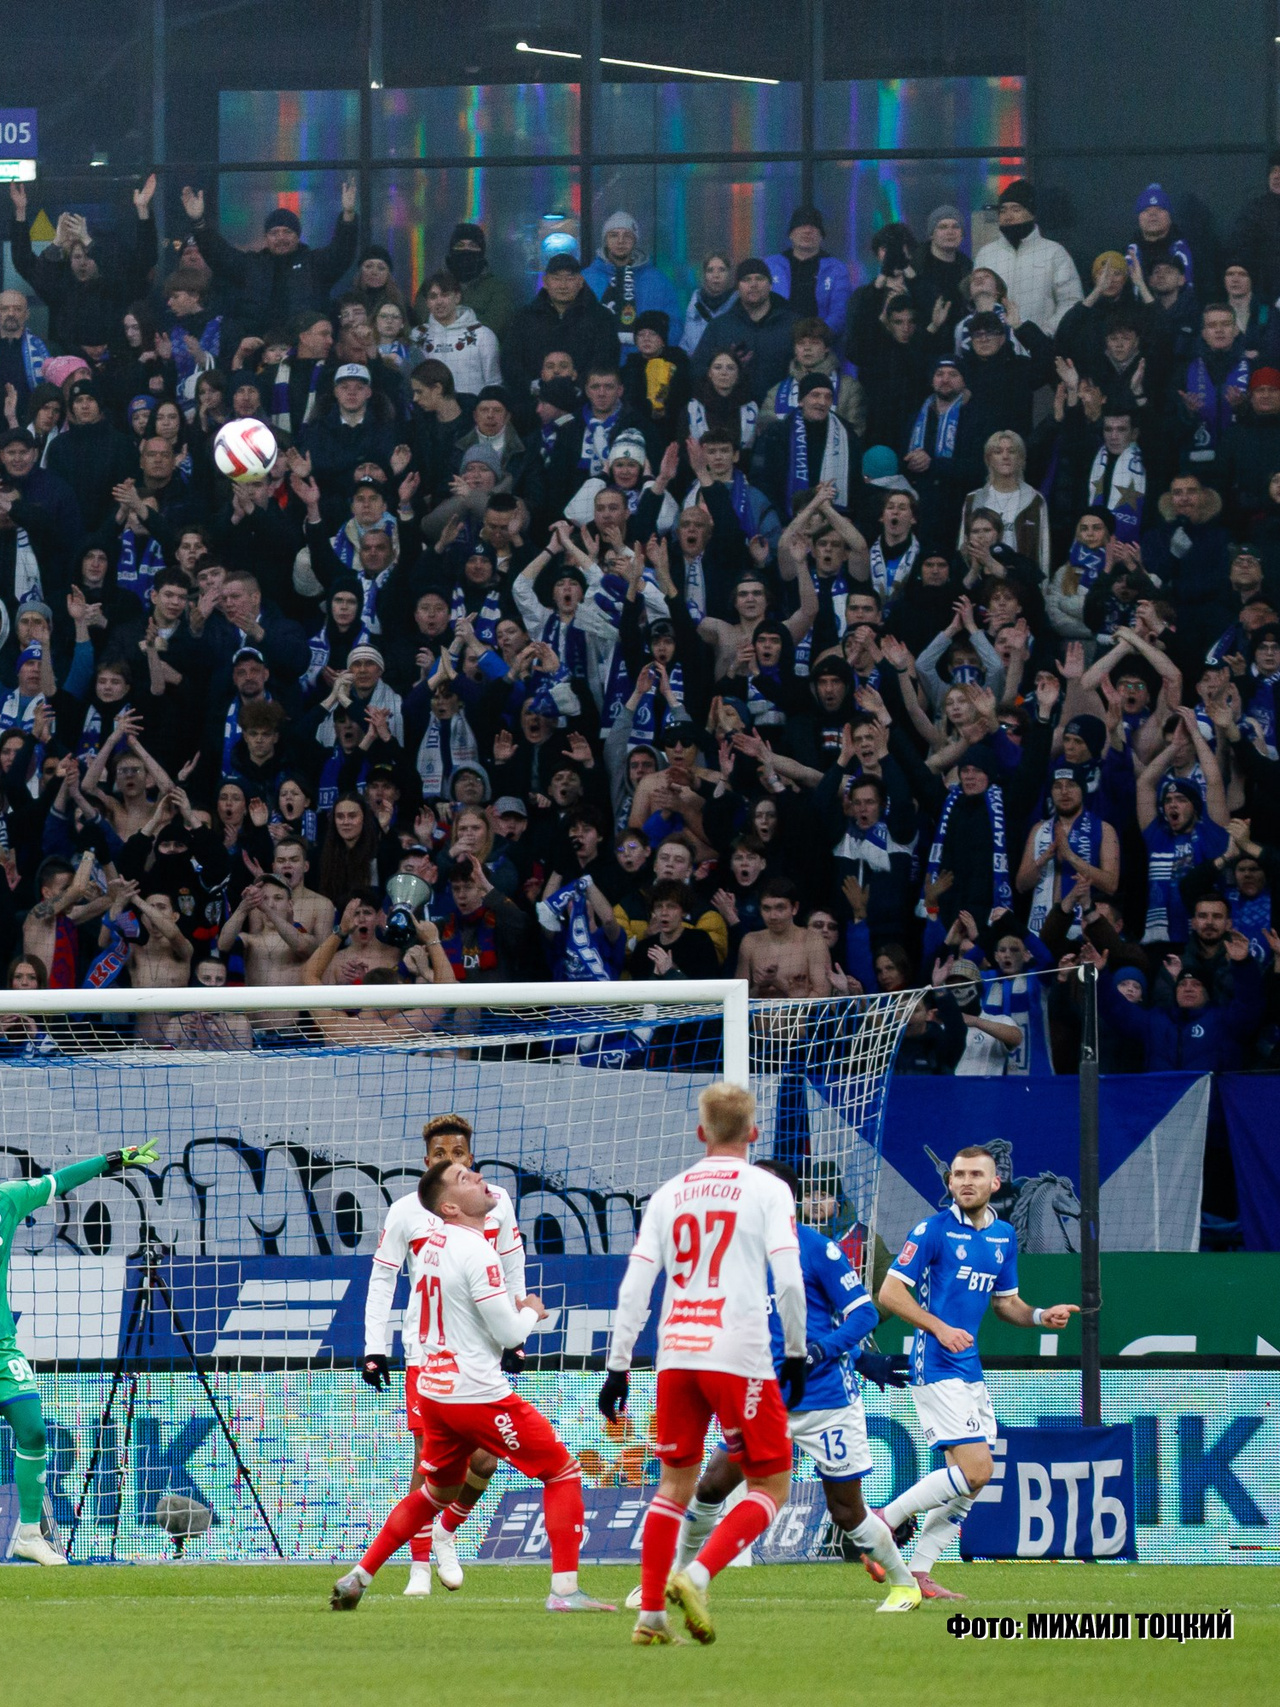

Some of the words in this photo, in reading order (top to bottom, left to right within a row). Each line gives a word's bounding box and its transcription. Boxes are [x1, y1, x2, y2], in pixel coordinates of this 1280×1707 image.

[794, 409, 809, 481] ДИНАМ
[674, 1183, 742, 1208] ДЕНИСОВ
[672, 1211, 737, 1288] 97
[968, 1272, 998, 1293] ВТБ
[415, 1274, 446, 1345] 17
[7, 1357, 35, 1381] 99
[820, 1429, 847, 1461] 13
[1017, 1459, 1127, 1557] ВТБ
